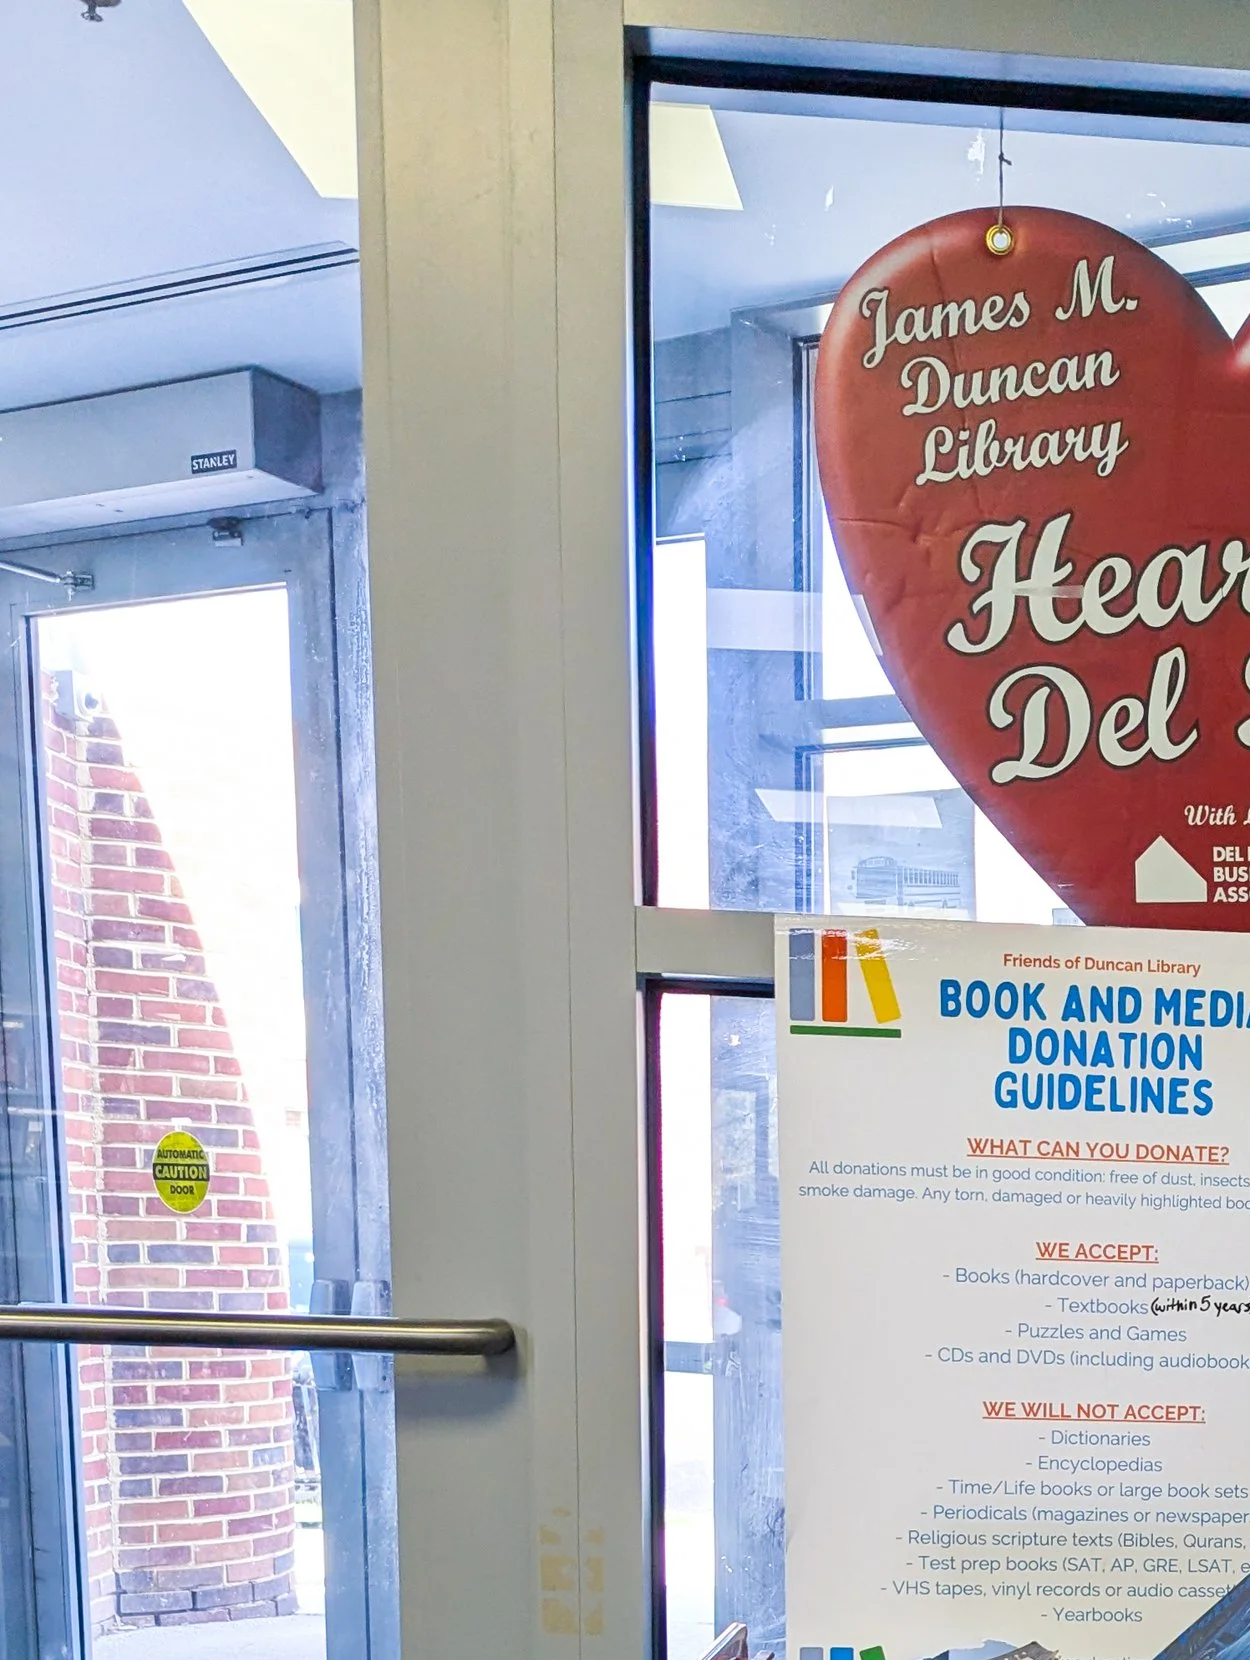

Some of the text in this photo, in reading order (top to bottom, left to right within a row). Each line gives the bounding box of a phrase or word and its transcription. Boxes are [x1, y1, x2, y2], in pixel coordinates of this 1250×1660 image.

[859, 254, 1139, 371] James M.
[899, 346, 1120, 420] Duncan
[192, 453, 235, 471] STANLEY
[915, 420, 1131, 487] Library
[988, 646, 1198, 786] Del
[1184, 803, 1238, 829] With
[1212, 844, 1244, 863] DEL
[1003, 952, 1201, 979] Friends of Duncan Library
[938, 978, 1047, 1023] BOOK
[1060, 983, 1142, 1025] AND
[1008, 1026, 1203, 1073] DONATION
[994, 1070, 1214, 1118] GUIDELINES
[157, 1149, 206, 1159] AUTOMATIC
[966, 1137, 1230, 1164] WHAT CAN YOU DONATE?
[155, 1165, 208, 1180] CAUTION
[808, 1159, 830, 1176] All
[832, 1160, 907, 1178] donations
[910, 1163, 949, 1179] must
[952, 1163, 972, 1180] be
[975, 1164, 989, 1180] in
[991, 1166, 1031, 1184] good
[1034, 1168, 1106, 1184] condition:
[1109, 1168, 1139, 1186] free
[1142, 1170, 1159, 1186] of
[1160, 1170, 1196, 1187] dust,
[169, 1185, 195, 1195] DOOR
[798, 1183, 850, 1198] smoke
[852, 1183, 918, 1203] damage.
[921, 1186, 952, 1204] Any
[954, 1187, 988, 1203] torn,
[991, 1188, 1063, 1208] damaged
[1066, 1193, 1082, 1206] or
[1085, 1191, 1137, 1211] heavily
[1140, 1191, 1222, 1212] highlighted
[1035, 1241, 1159, 1262] WE ACCEPT:
[955, 1266, 1250, 1294] Books (hardcover and paperback)
[1056, 1296, 1149, 1316] Textbooks
[1150, 1296, 1198, 1318] (within
[1199, 1293, 1212, 1313] 5
[1018, 1322, 1188, 1343] Puzzles and Games
[937, 1346, 974, 1364] CDs
[978, 1347, 1012, 1365] and
[1016, 1347, 1066, 1366] DVDs
[1070, 1349, 1154, 1373] (including
[982, 1400, 1206, 1422] WE WILL NOT ACCEPT:
[1051, 1428, 1151, 1447] Dictionaries
[1038, 1454, 1163, 1476] Encyclopedias
[947, 1478, 1249, 1502] Time/Life books or large book sets
[933, 1503, 1028, 1521] Periodicals
[1031, 1504, 1129, 1527] (magazines
[1133, 1510, 1152, 1524] or
[908, 1529, 987, 1550] Religious
[991, 1530, 1068, 1551] scripture
[1072, 1531, 1113, 1549] texts
[1117, 1531, 1178, 1550] (Bibles,
[1183, 1533, 1246, 1551] Qurans,
[917, 1555, 957, 1572] Test
[961, 1558, 1001, 1575] prep
[1005, 1554, 1058, 1573] books
[1062, 1556, 1106, 1574] (SAT,
[1109, 1557, 1138, 1575] AP,
[1142, 1557, 1182, 1575] GRE,
[1187, 1557, 1236, 1575] LSAT,
[892, 1579, 931, 1596] VHS
[935, 1580, 987, 1600] tapes,
[991, 1580, 1032, 1601] vinyl
[1036, 1580, 1101, 1598] records
[1104, 1585, 1123, 1599] or
[1126, 1582, 1174, 1599] audio
[1052, 1606, 1143, 1624] Yearbooks
